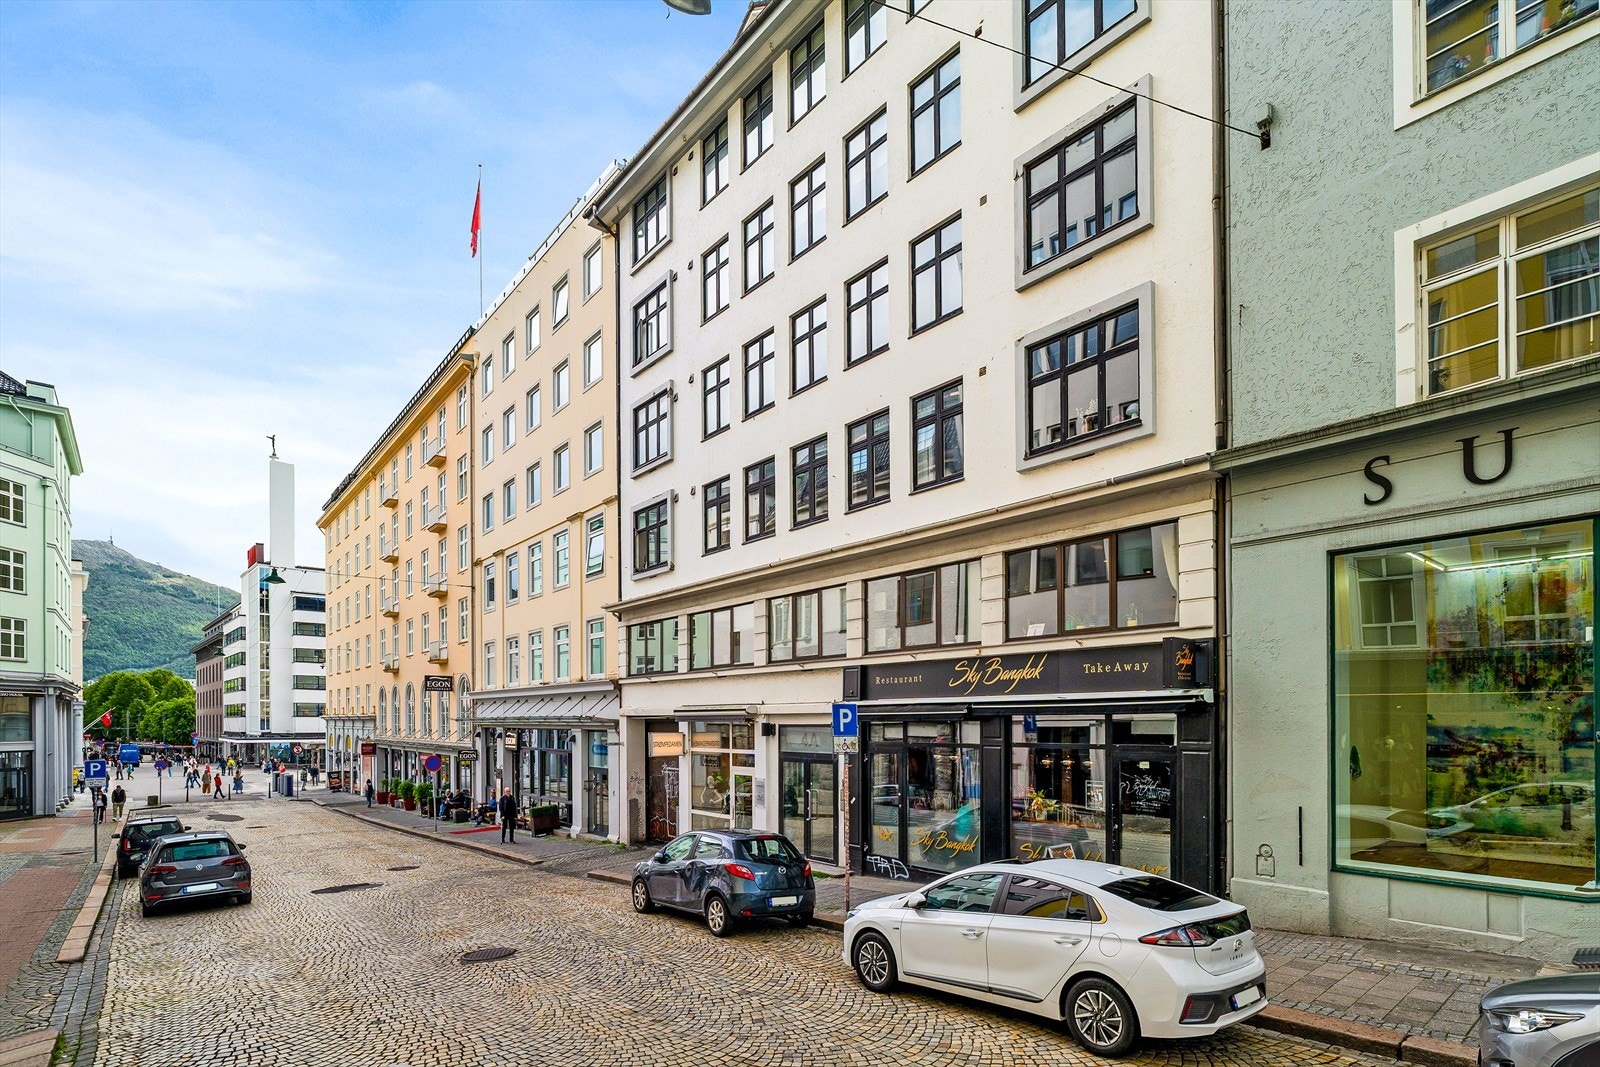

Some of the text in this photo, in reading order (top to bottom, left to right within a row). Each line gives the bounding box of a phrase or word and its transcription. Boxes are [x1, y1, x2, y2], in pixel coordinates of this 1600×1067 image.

[875, 674, 923, 685] Restaurant
[949, 653, 1048, 695] Sky Bangkok
[839, 708, 852, 733] P
[90, 762, 102, 776] P
[911, 827, 979, 858] Sky Bangkok
